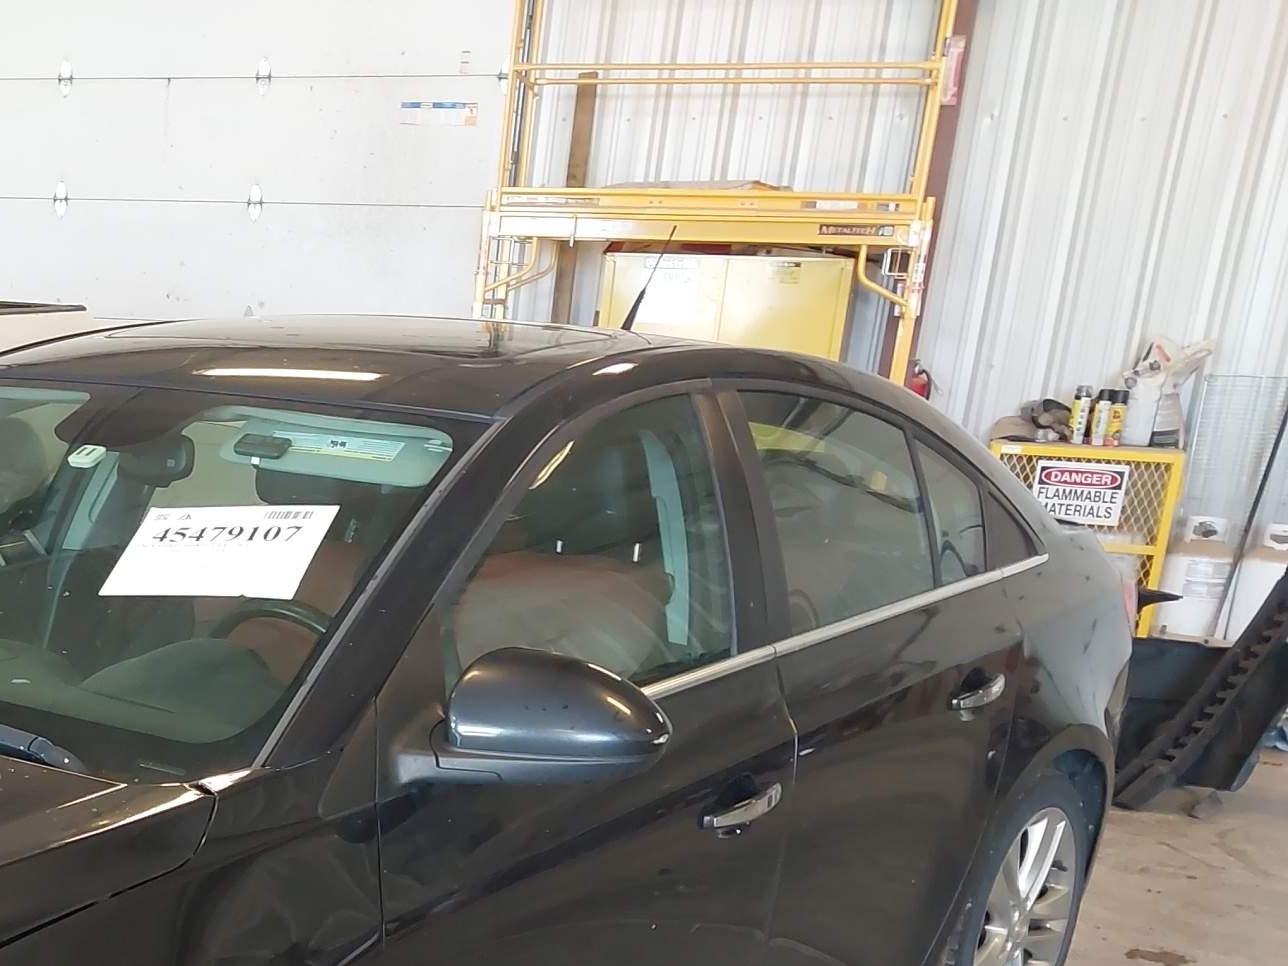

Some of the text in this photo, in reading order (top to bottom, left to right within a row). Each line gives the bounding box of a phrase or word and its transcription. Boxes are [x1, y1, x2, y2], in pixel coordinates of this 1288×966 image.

[1050, 471, 1113, 486] DANGER
[1037, 486, 1120, 504] FLAMMABLE
[152, 525, 302, 543] 45479107
